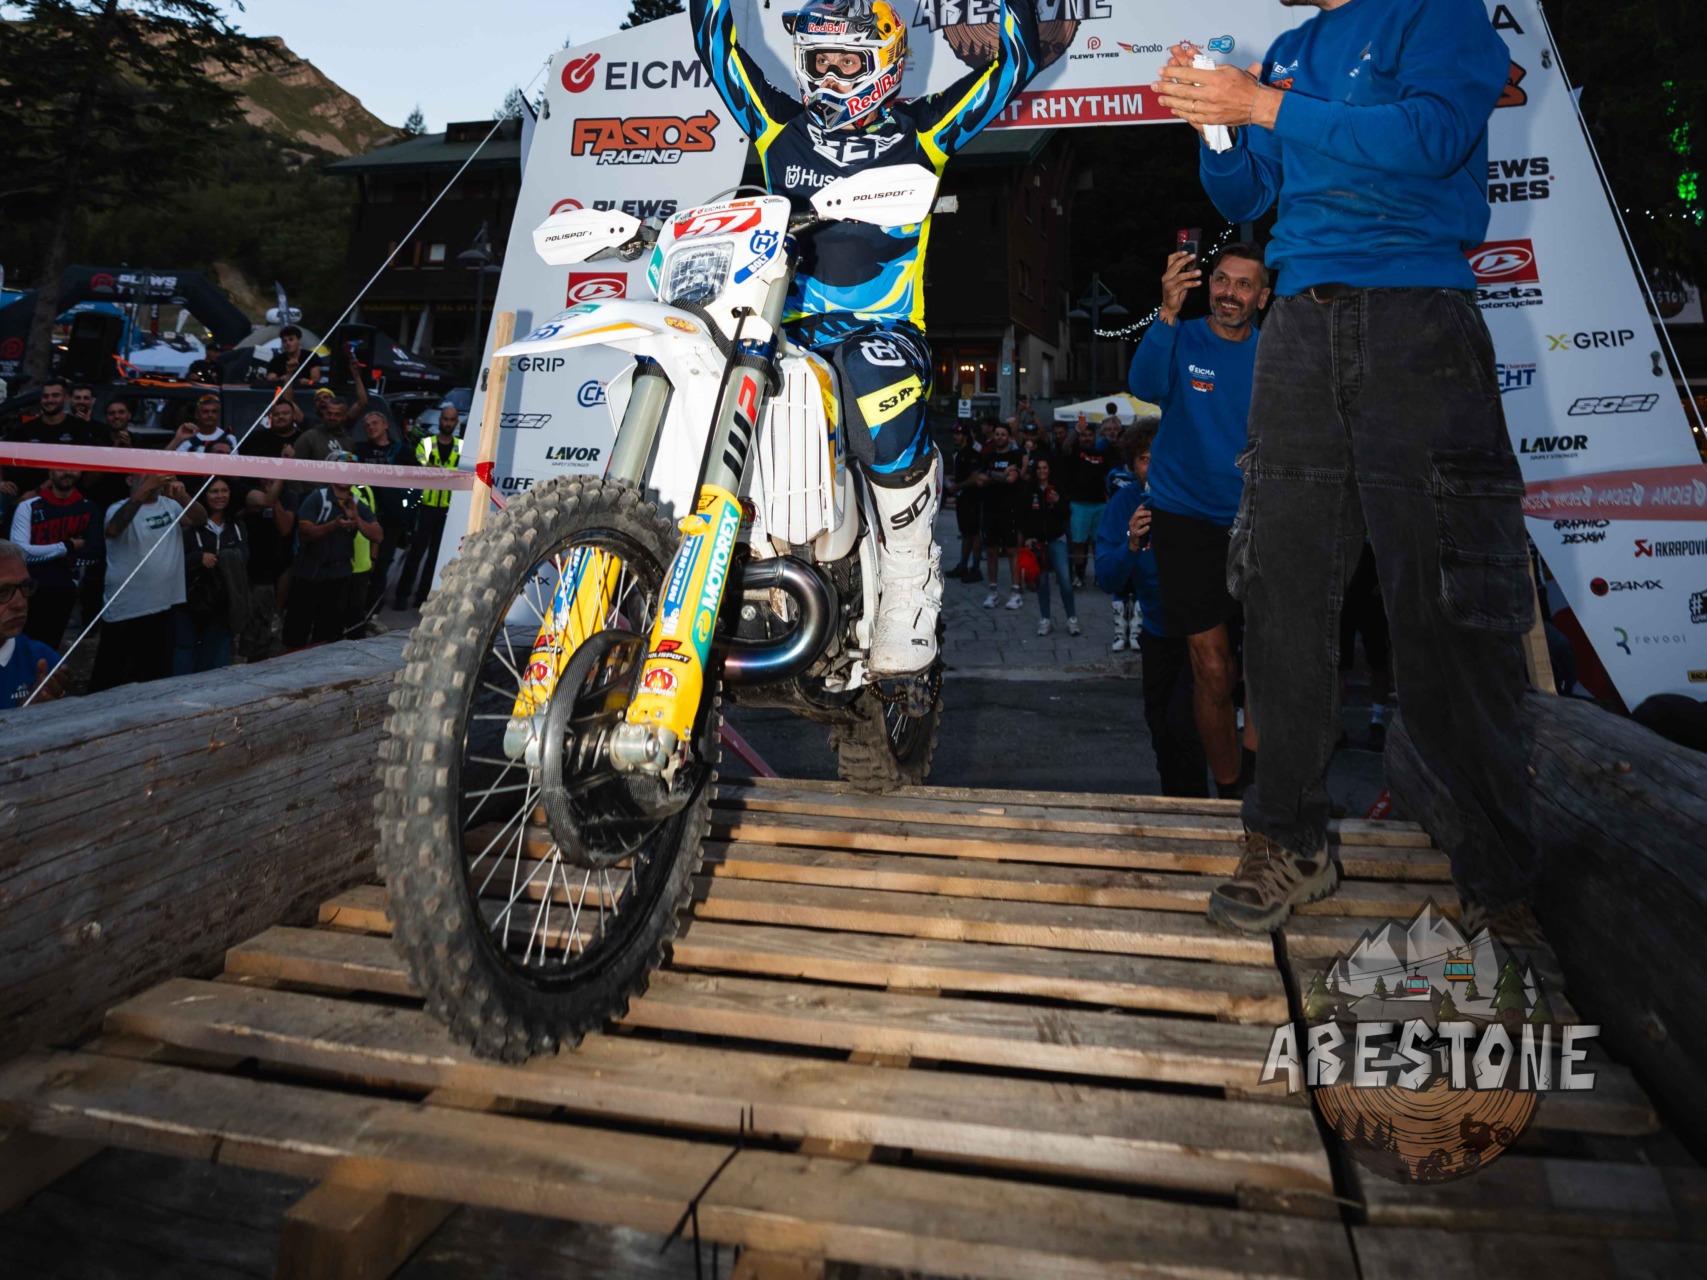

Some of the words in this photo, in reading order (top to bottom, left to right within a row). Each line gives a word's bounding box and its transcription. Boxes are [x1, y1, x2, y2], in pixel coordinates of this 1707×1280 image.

[1131, 43, 1163, 53] Gmoto
[604, 60, 714, 90] EICM
[846, 81, 881, 118] Red
[1031, 93, 1143, 120] RHYTHM
[597, 149, 683, 165] RACING
[1488, 180, 1550, 203] RES
[747, 253, 770, 272] BOLT
[1477, 298, 1544, 310] otorcycles
[1545, 329, 1635, 351] X-GRIP
[879, 396, 899, 412] S3
[500, 413, 552, 429] OSI
[1520, 434, 1588, 454] LAVOR
[545, 446, 601, 461] LAVOR
[502, 477, 535, 490] OFF
[1561, 530, 1606, 545] DESIGN
[702, 510, 739, 612] MOTOREX
[1610, 579, 1664, 591] 24MX
